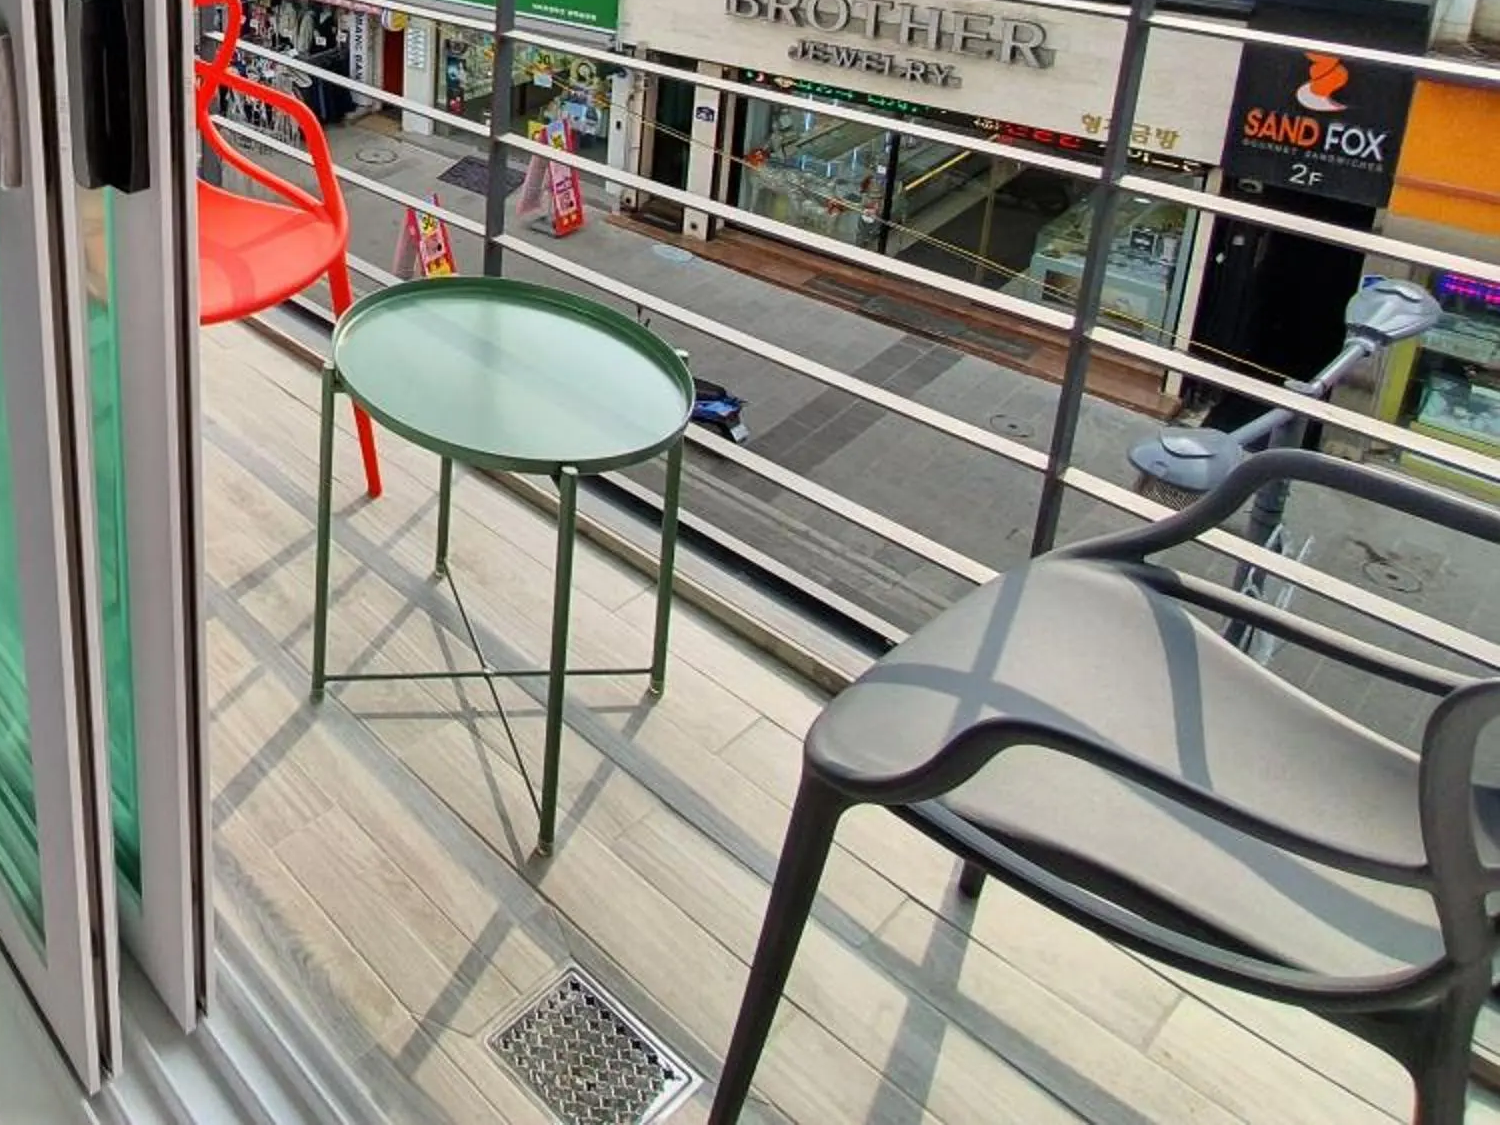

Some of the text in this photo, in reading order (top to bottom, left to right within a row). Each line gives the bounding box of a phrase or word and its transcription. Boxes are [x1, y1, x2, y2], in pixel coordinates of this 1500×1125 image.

[788, 40, 963, 88] JEWELRY
[1243, 108, 1388, 162] SAND FOX
[1289, 164, 1323, 186] 2F
